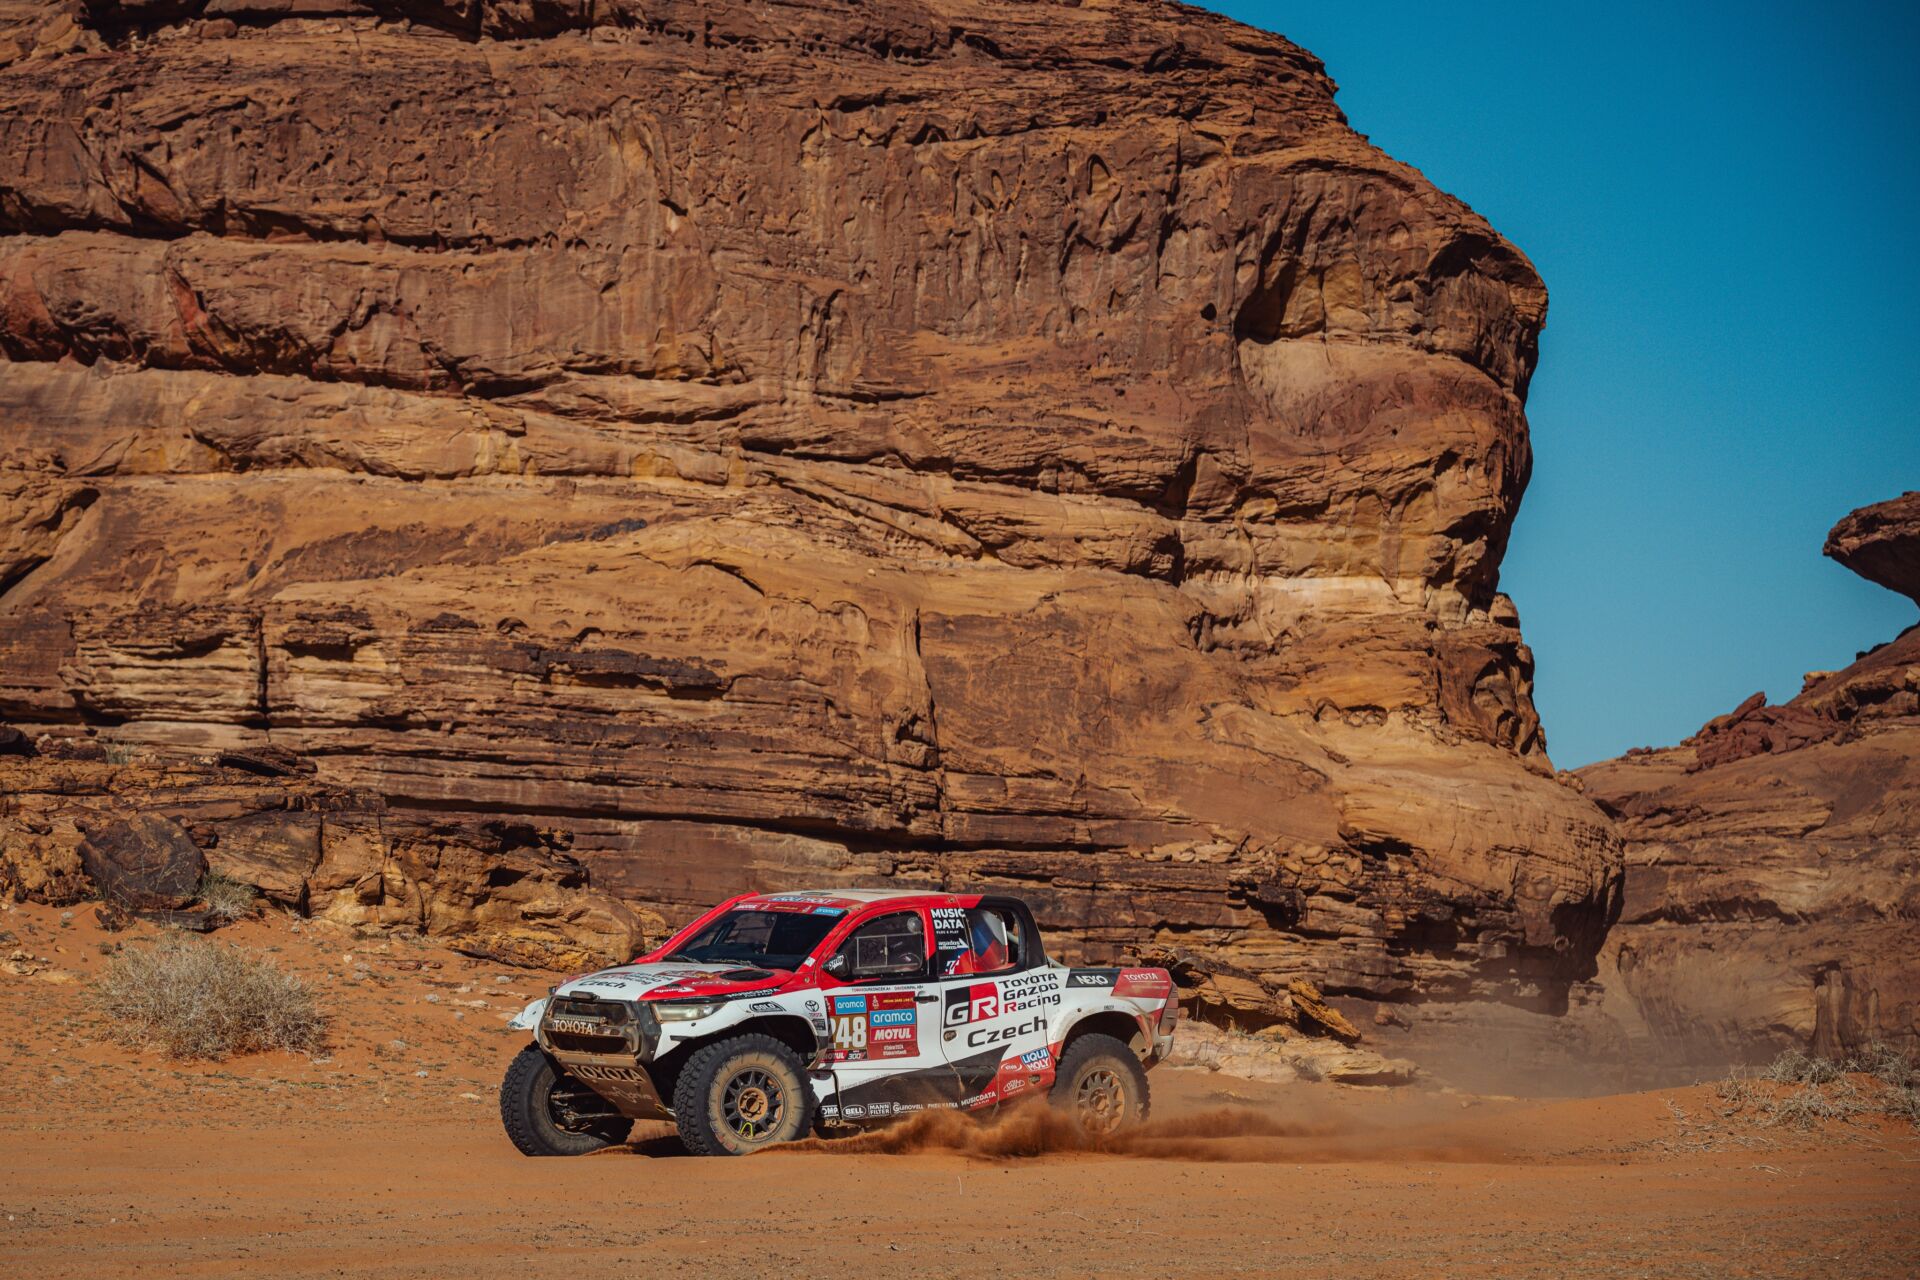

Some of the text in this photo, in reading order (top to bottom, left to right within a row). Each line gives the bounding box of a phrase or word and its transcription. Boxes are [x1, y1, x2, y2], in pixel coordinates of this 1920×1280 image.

[930, 908, 966, 919] MUSIC
[934, 919, 965, 929] DATA
[999, 972, 1058, 989] TOYOTA
[1075, 975, 1109, 986] NEXO
[1123, 972, 1159, 981] TOYOTA
[1003, 982, 1059, 1001] GAZOO
[837, 999, 865, 1010] aramco
[945, 996, 998, 1026] GR
[1003, 993, 1061, 1014] Racing
[873, 1011, 913, 1023] aramco
[553, 1020, 593, 1036] TOYOTA
[874, 1028, 912, 1041] MOTUL
[967, 1015, 1048, 1048] Czech
[1022, 1047, 1048, 1064] LIQUI
[1027, 1057, 1050, 1072] MOLY
[568, 1063, 647, 1083] TOYOTA
[845, 1106, 864, 1115] BELL
